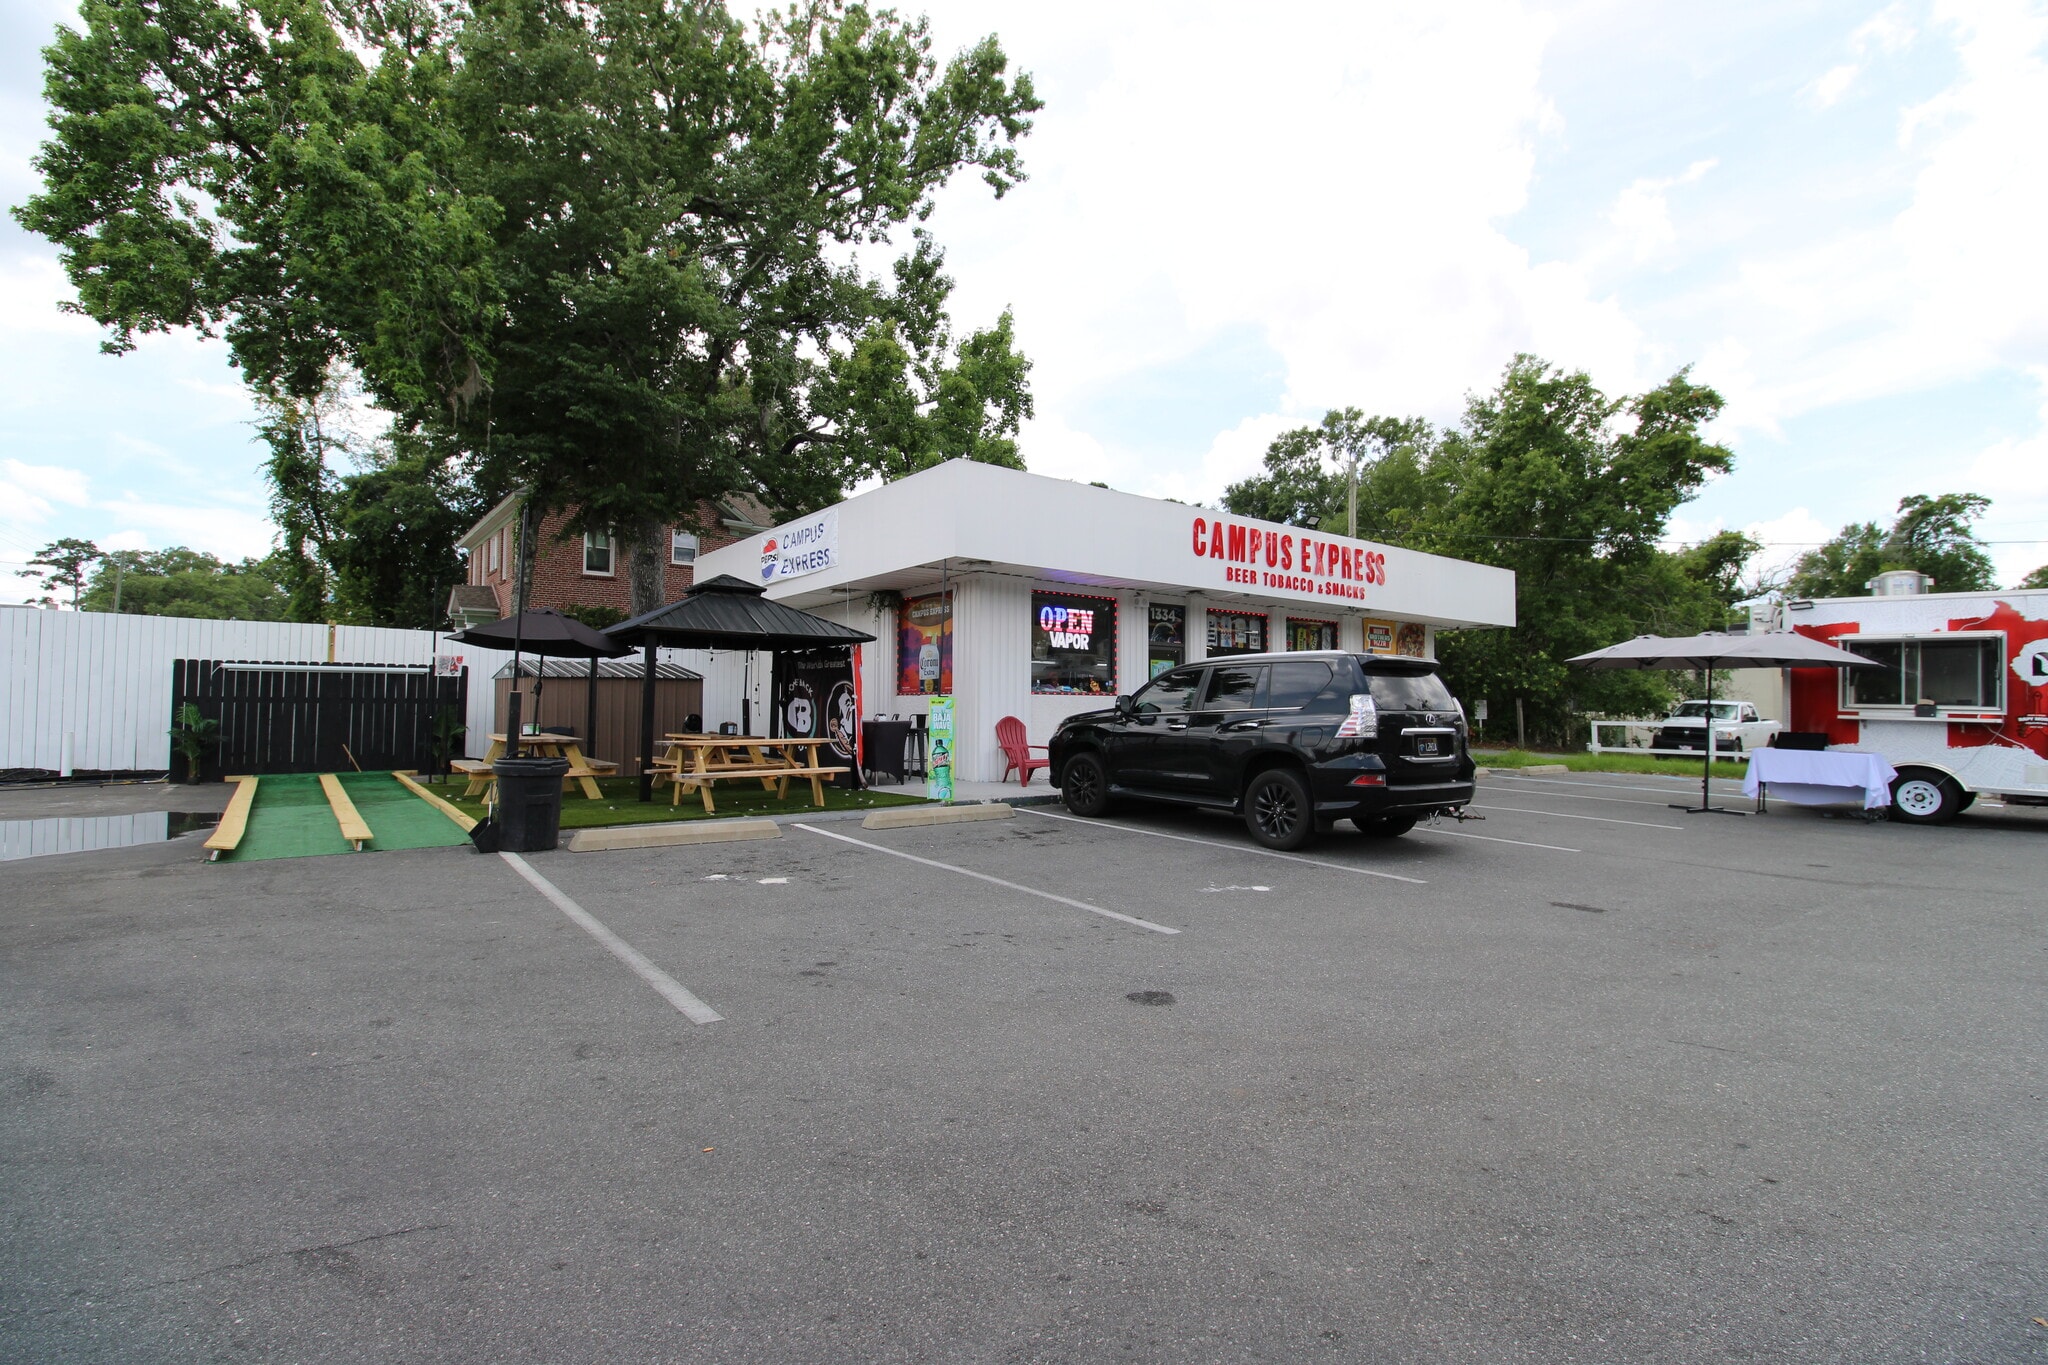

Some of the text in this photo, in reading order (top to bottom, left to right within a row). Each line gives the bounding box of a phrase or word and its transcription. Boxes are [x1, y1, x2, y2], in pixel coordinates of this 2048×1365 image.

[782, 523, 824, 550] CAMPUS
[760, 553, 778, 564] PEPSI
[780, 548, 830, 574] EXPRESS
[1192, 517, 1386, 586] CAMPUS EXPRESS
[1226, 567, 1365, 600] BEER TOBACCO & SNACKS
[930, 605, 950, 616] EXPRSS
[1040, 606, 1094, 634] OPEN
[1150, 608, 1176, 622] 1334
[1049, 631, 1089, 650] VAPOR
[933, 713, 951, 722] BAJA
[934, 722, 951, 730] WAVE
